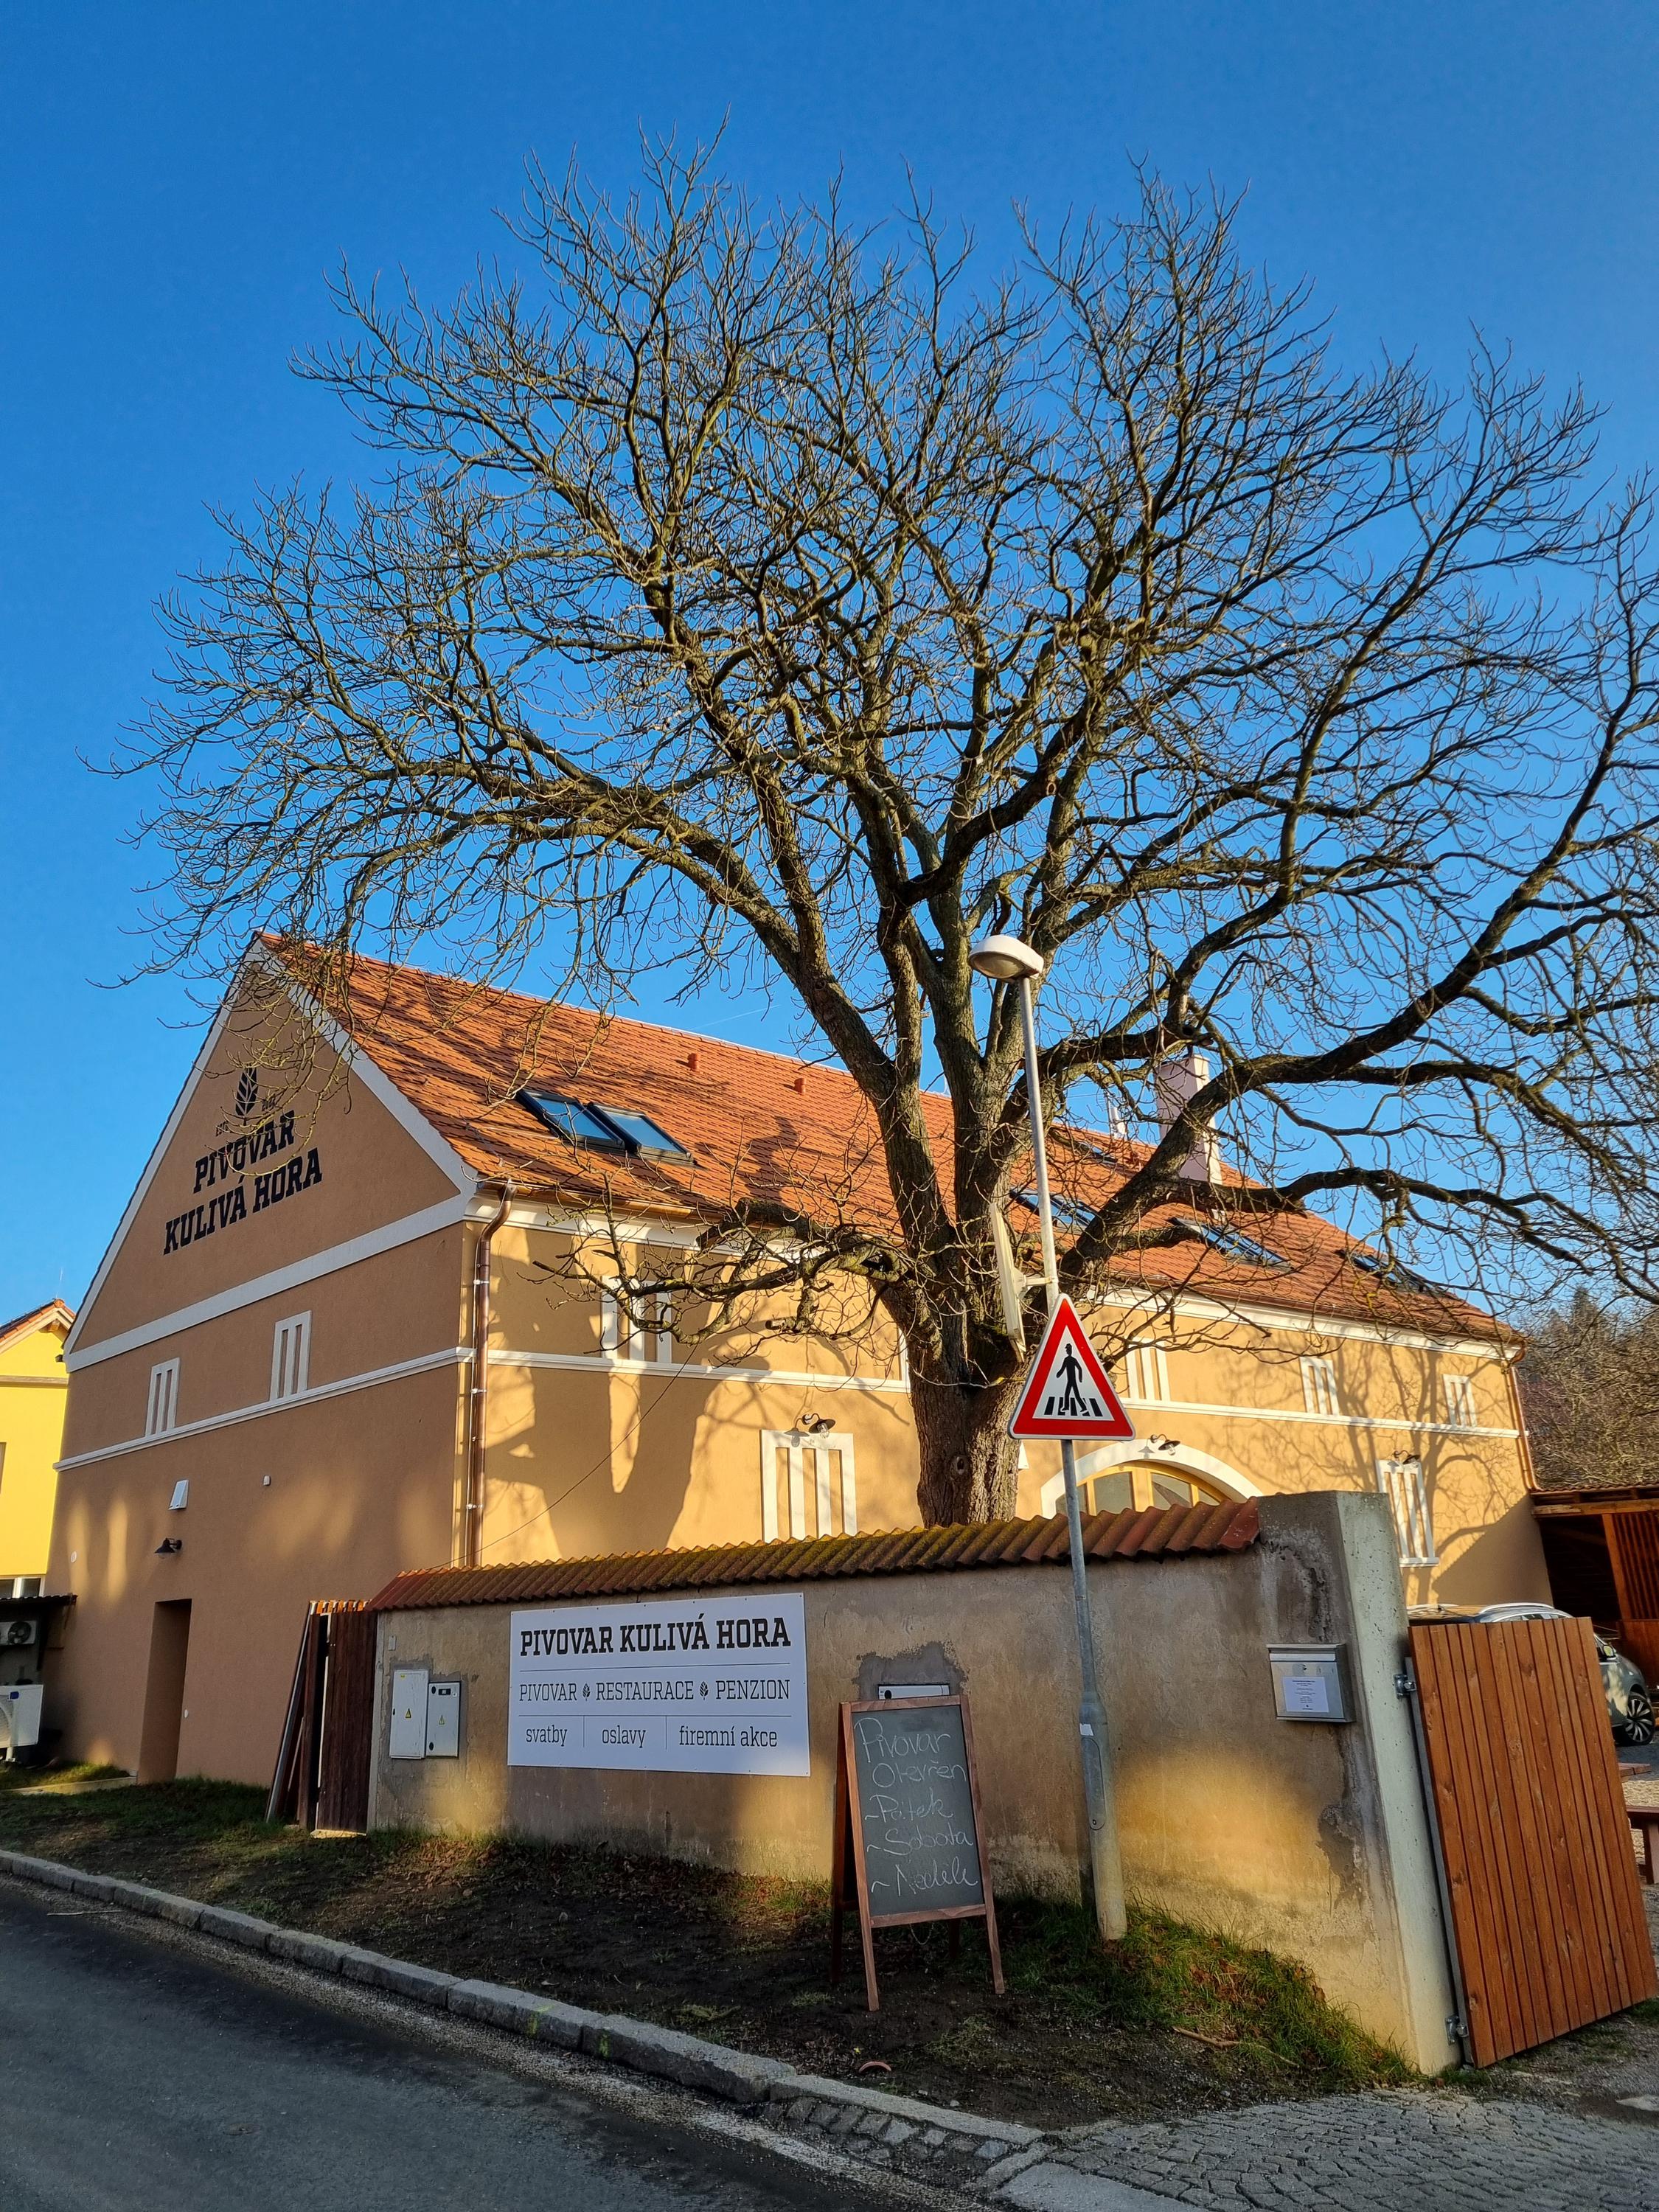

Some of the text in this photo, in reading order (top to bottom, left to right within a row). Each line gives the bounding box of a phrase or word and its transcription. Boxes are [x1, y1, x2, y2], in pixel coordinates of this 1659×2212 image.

[193, 1110, 295, 1194] PIVOVAR
[164, 1147, 322, 1255] KULIVÁ HORA
[520, 1613, 791, 1656] PIVOVAR KULIVÁ HORA
[519, 1679, 790, 1702] PIVOVAR RESTAURACE PENZION
[525, 1725, 568, 1747] svatby
[602, 1725, 646, 1748] oslavy
[679, 1725, 777, 1747] firemní akce
[854, 1717, 951, 1763] Pivovar
